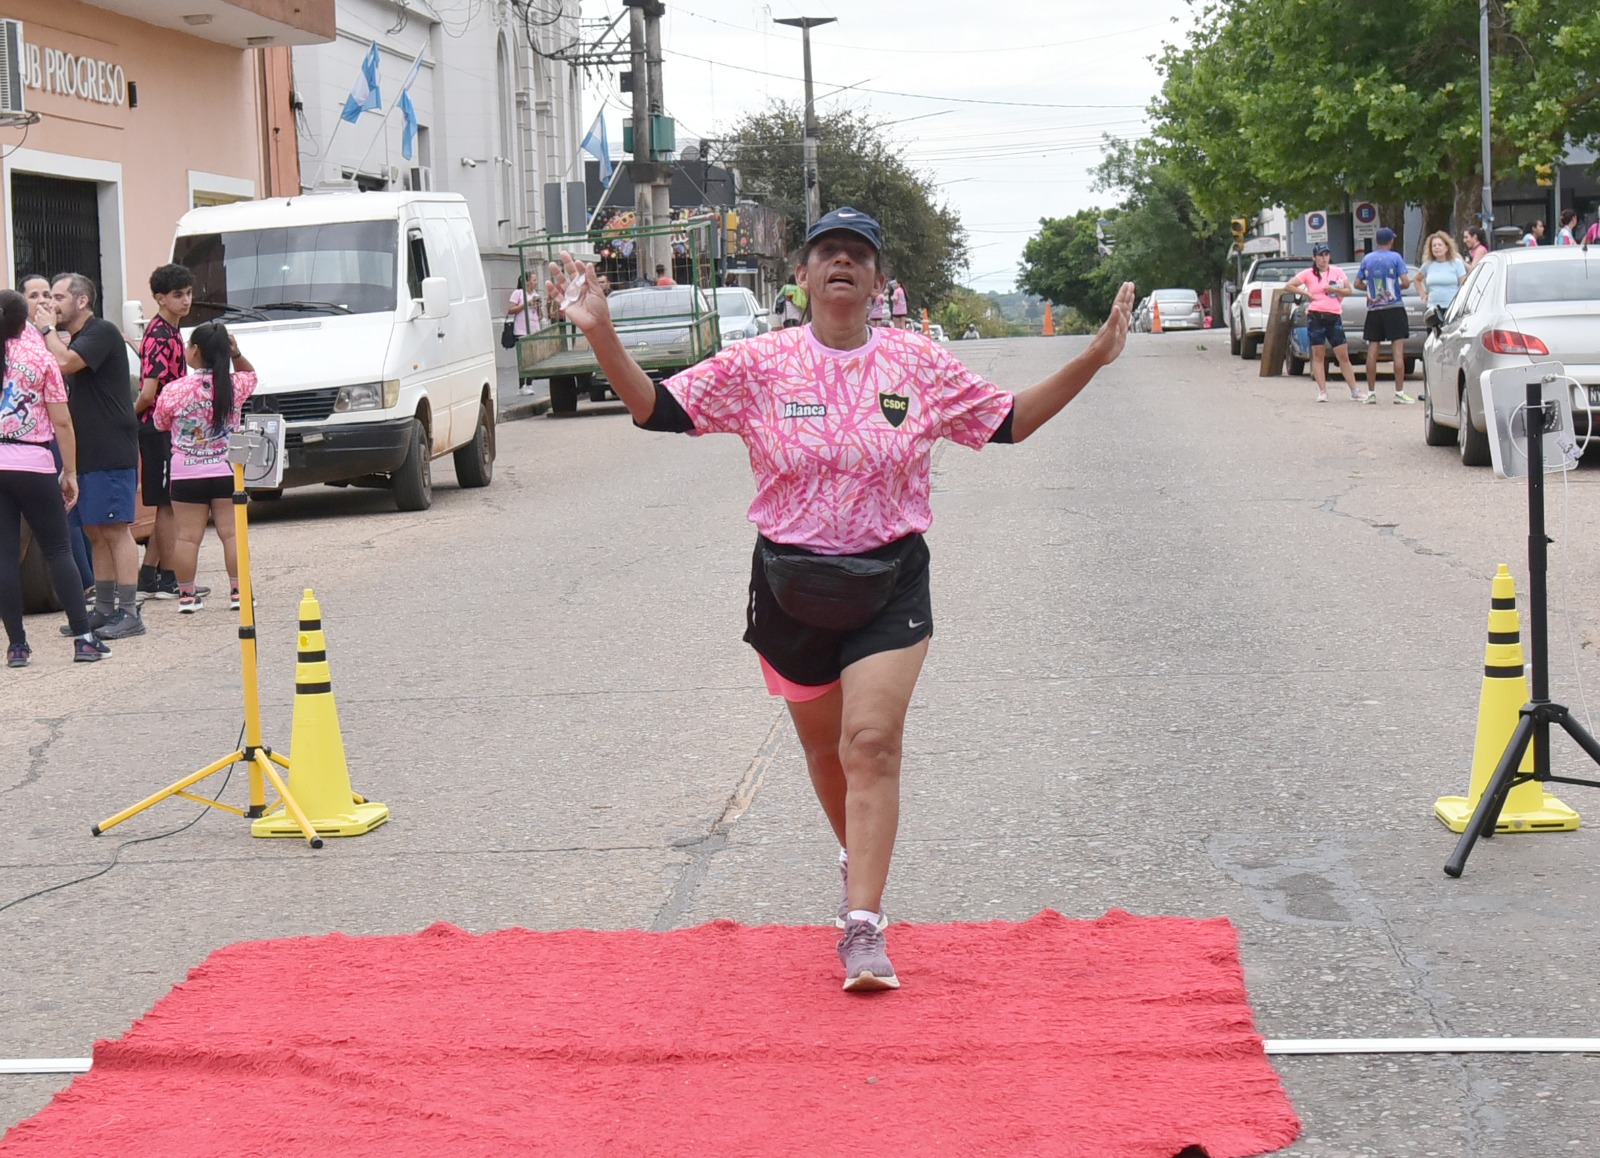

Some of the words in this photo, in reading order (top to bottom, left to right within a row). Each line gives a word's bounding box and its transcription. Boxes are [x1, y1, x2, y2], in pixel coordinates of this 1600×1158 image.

[45, 47, 125, 105] PROGRESO
[12, 361, 36, 382] ROSA
[784, 402, 826, 418] Blanca
[883, 398, 906, 410] CSDC
